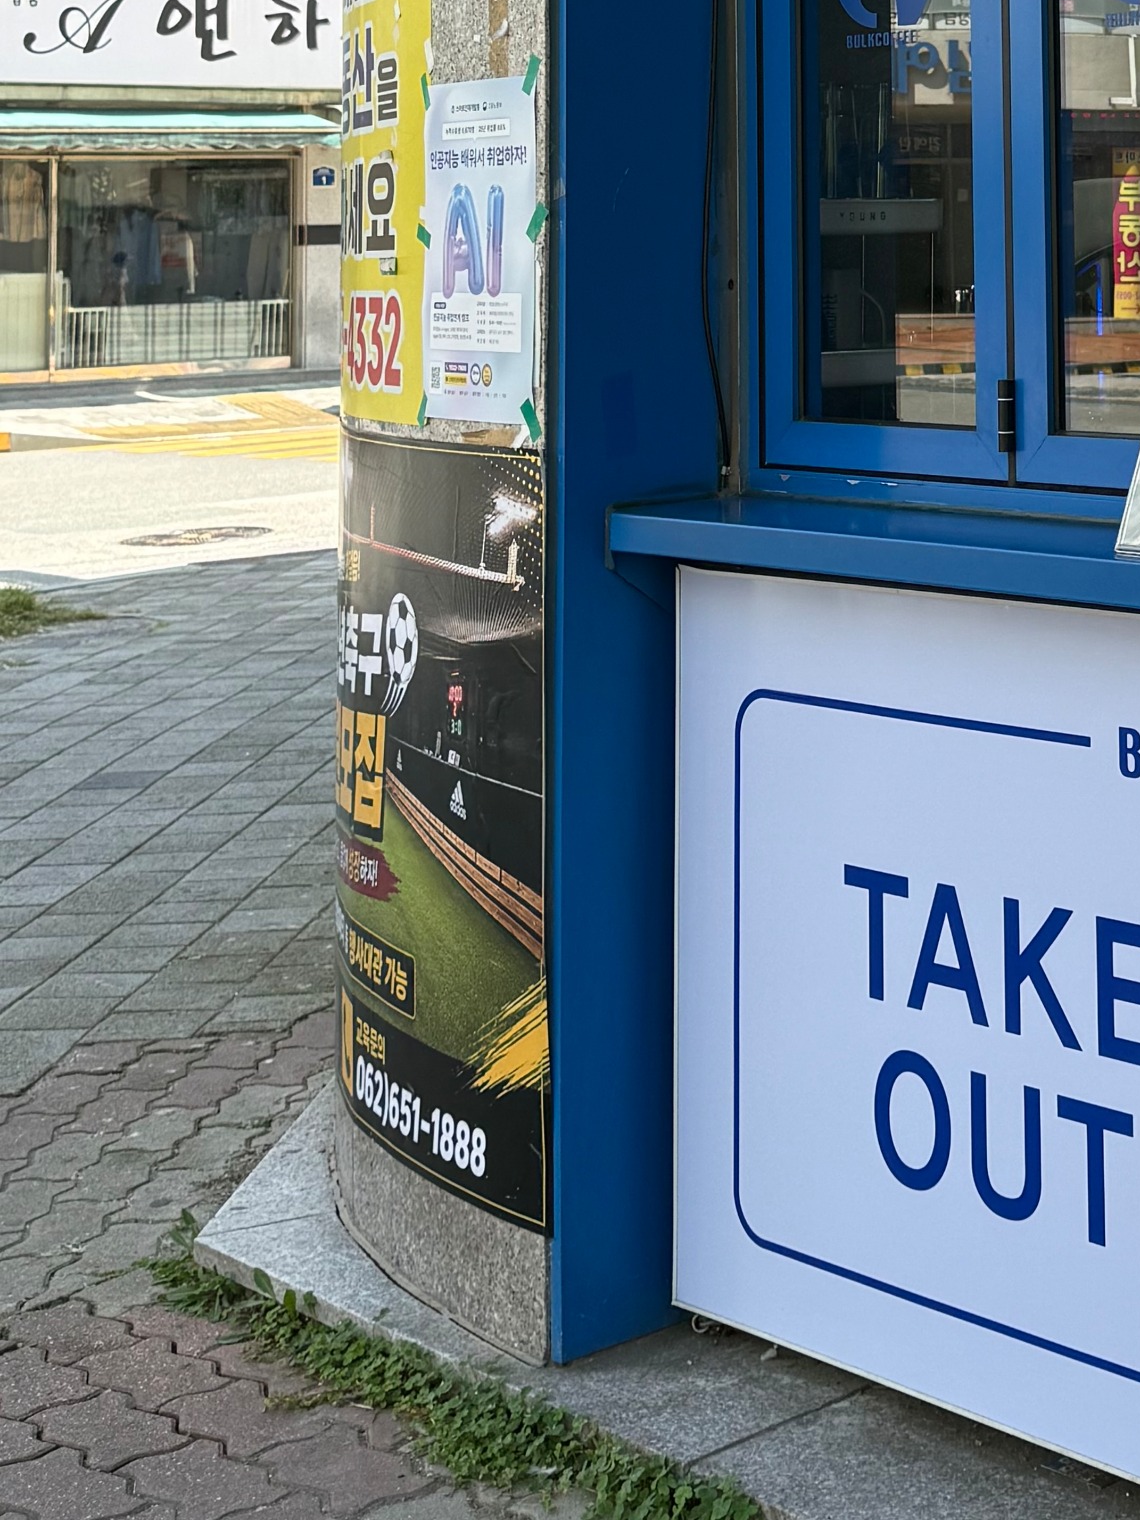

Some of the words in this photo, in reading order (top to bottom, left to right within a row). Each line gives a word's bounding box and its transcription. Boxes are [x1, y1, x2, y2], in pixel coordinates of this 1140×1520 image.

[846, 30, 919, 49] BULKCOFFEE
[430, 150, 459, 170] 인공지능
[461, 148, 485, 168] 배워서
[487, 145, 527, 167] 취업하자!
[443, 183, 505, 298] AI
[385, 958, 408, 1001] 가능
[356, 1016, 386, 1064] 교육문의
[356, 1055, 487, 1178] 062)651-1888
[873, 1048, 1135, 1248] OUT
